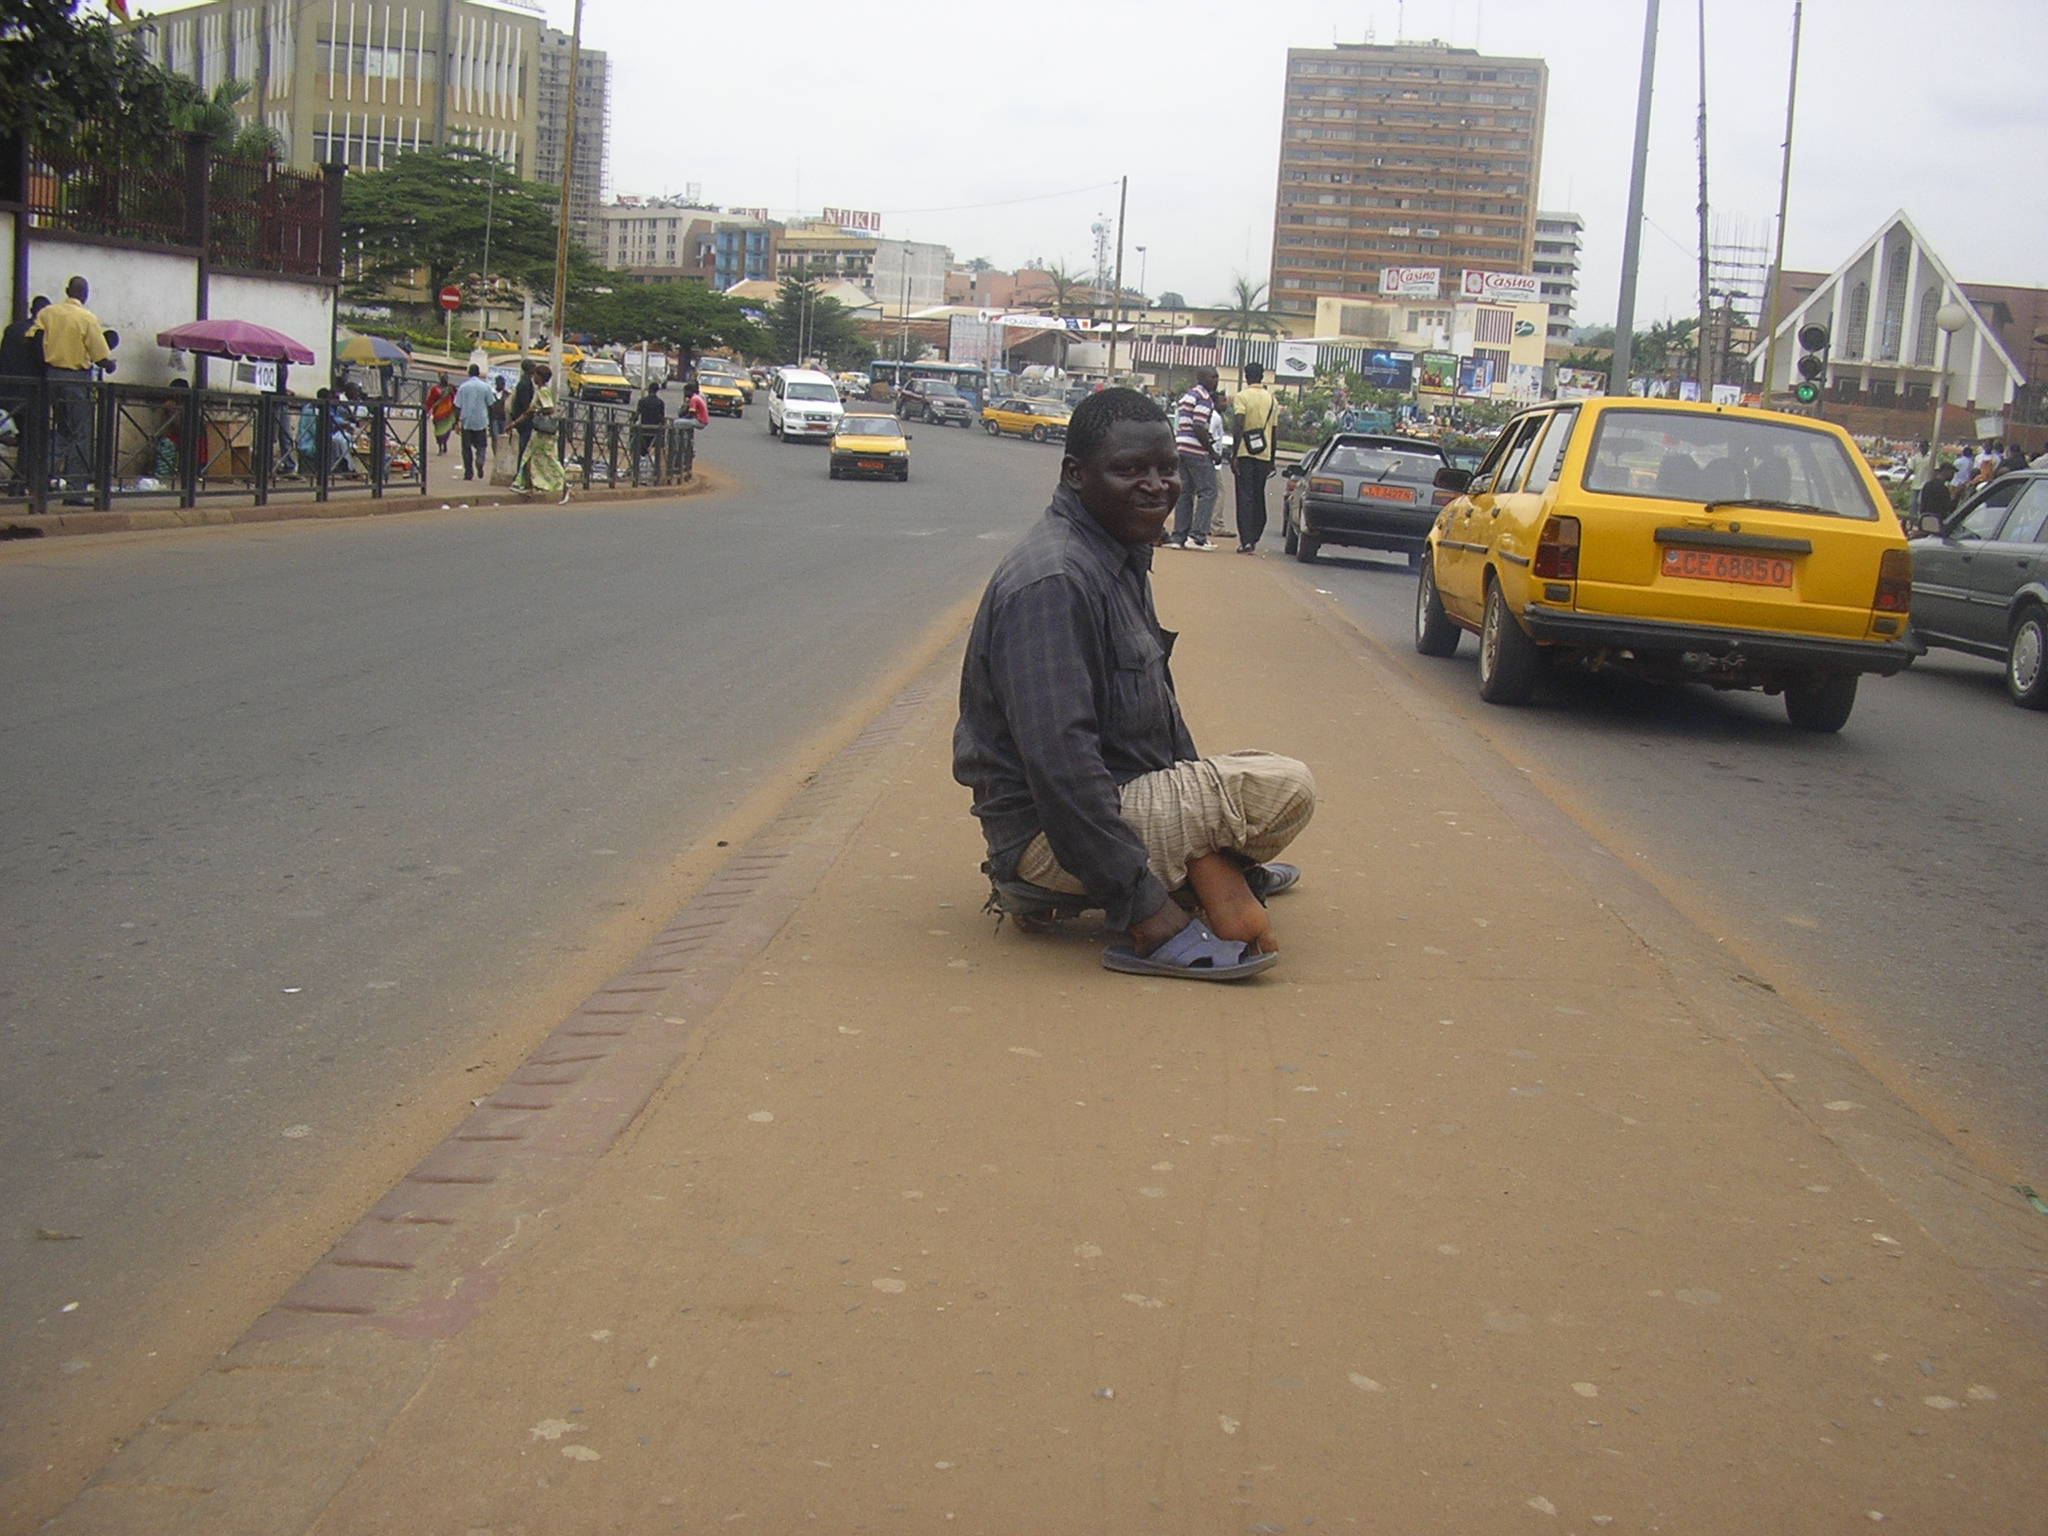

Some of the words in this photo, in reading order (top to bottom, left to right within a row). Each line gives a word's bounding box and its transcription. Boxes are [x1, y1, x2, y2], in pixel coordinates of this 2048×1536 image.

[824, 208, 880, 230] NIKI
[1400, 269, 1435, 284] Casino
[1485, 273, 1535, 289] Casino
[258, 367, 275, 387] 100
[1683, 552, 1711, 576] CE
